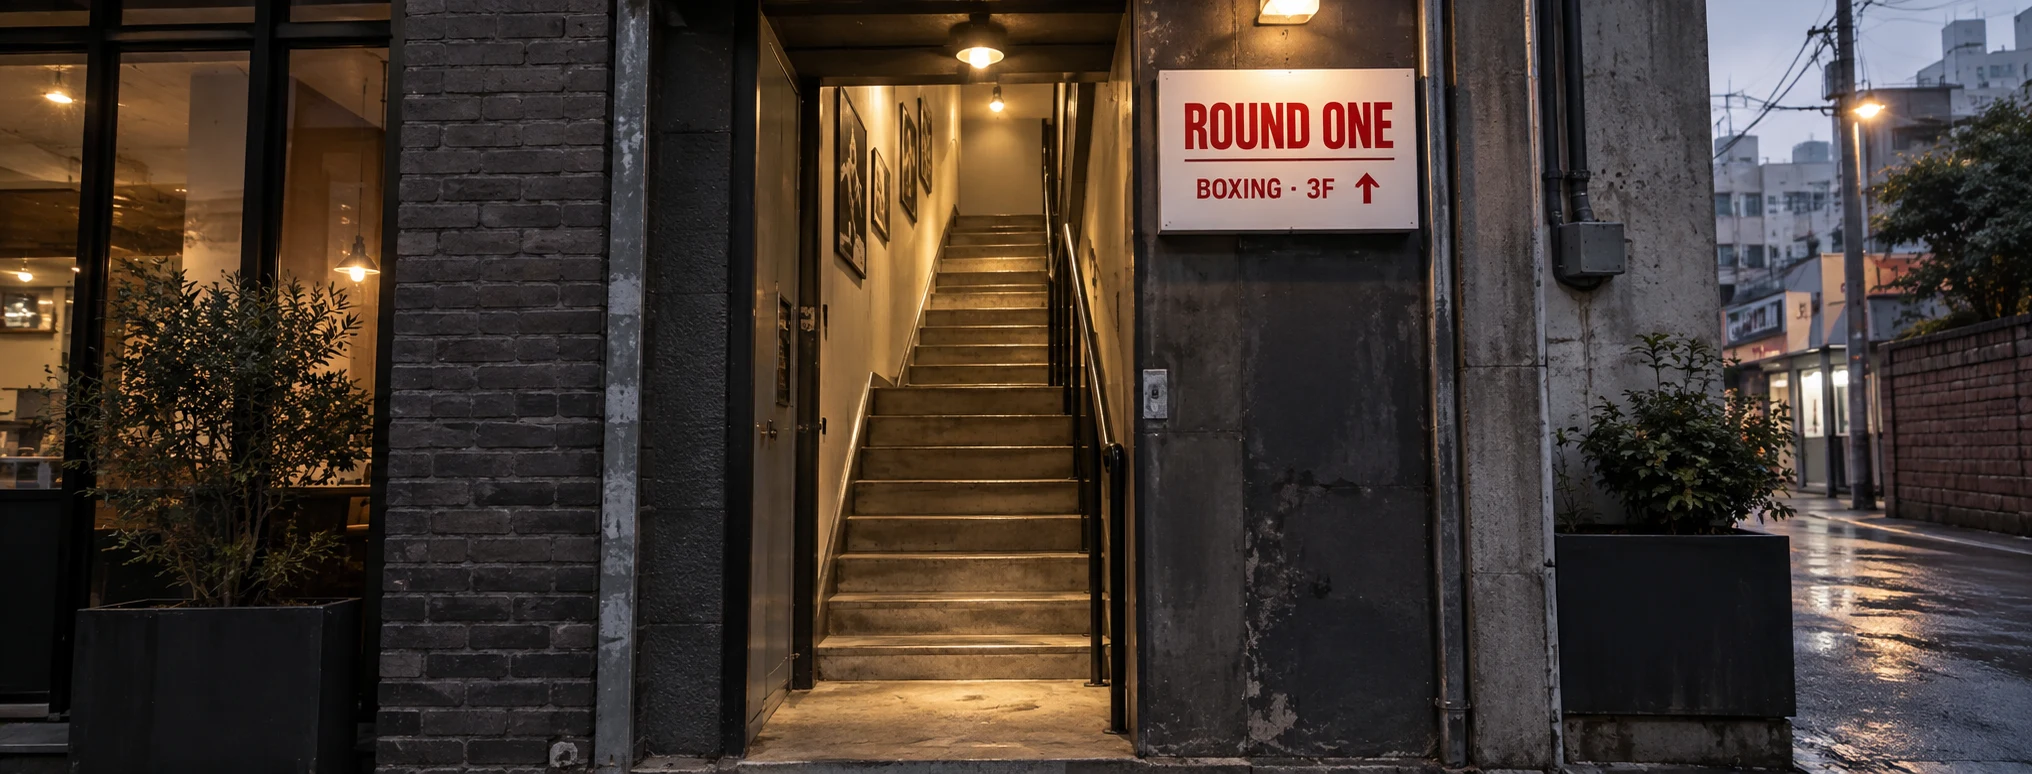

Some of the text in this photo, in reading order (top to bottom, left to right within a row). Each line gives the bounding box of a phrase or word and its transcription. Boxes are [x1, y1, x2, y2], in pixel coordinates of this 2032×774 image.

[1184, 101, 1394, 150] ROUND ONE
[1197, 178, 1281, 199] BOXING
[1308, 178, 1334, 198] 3F
